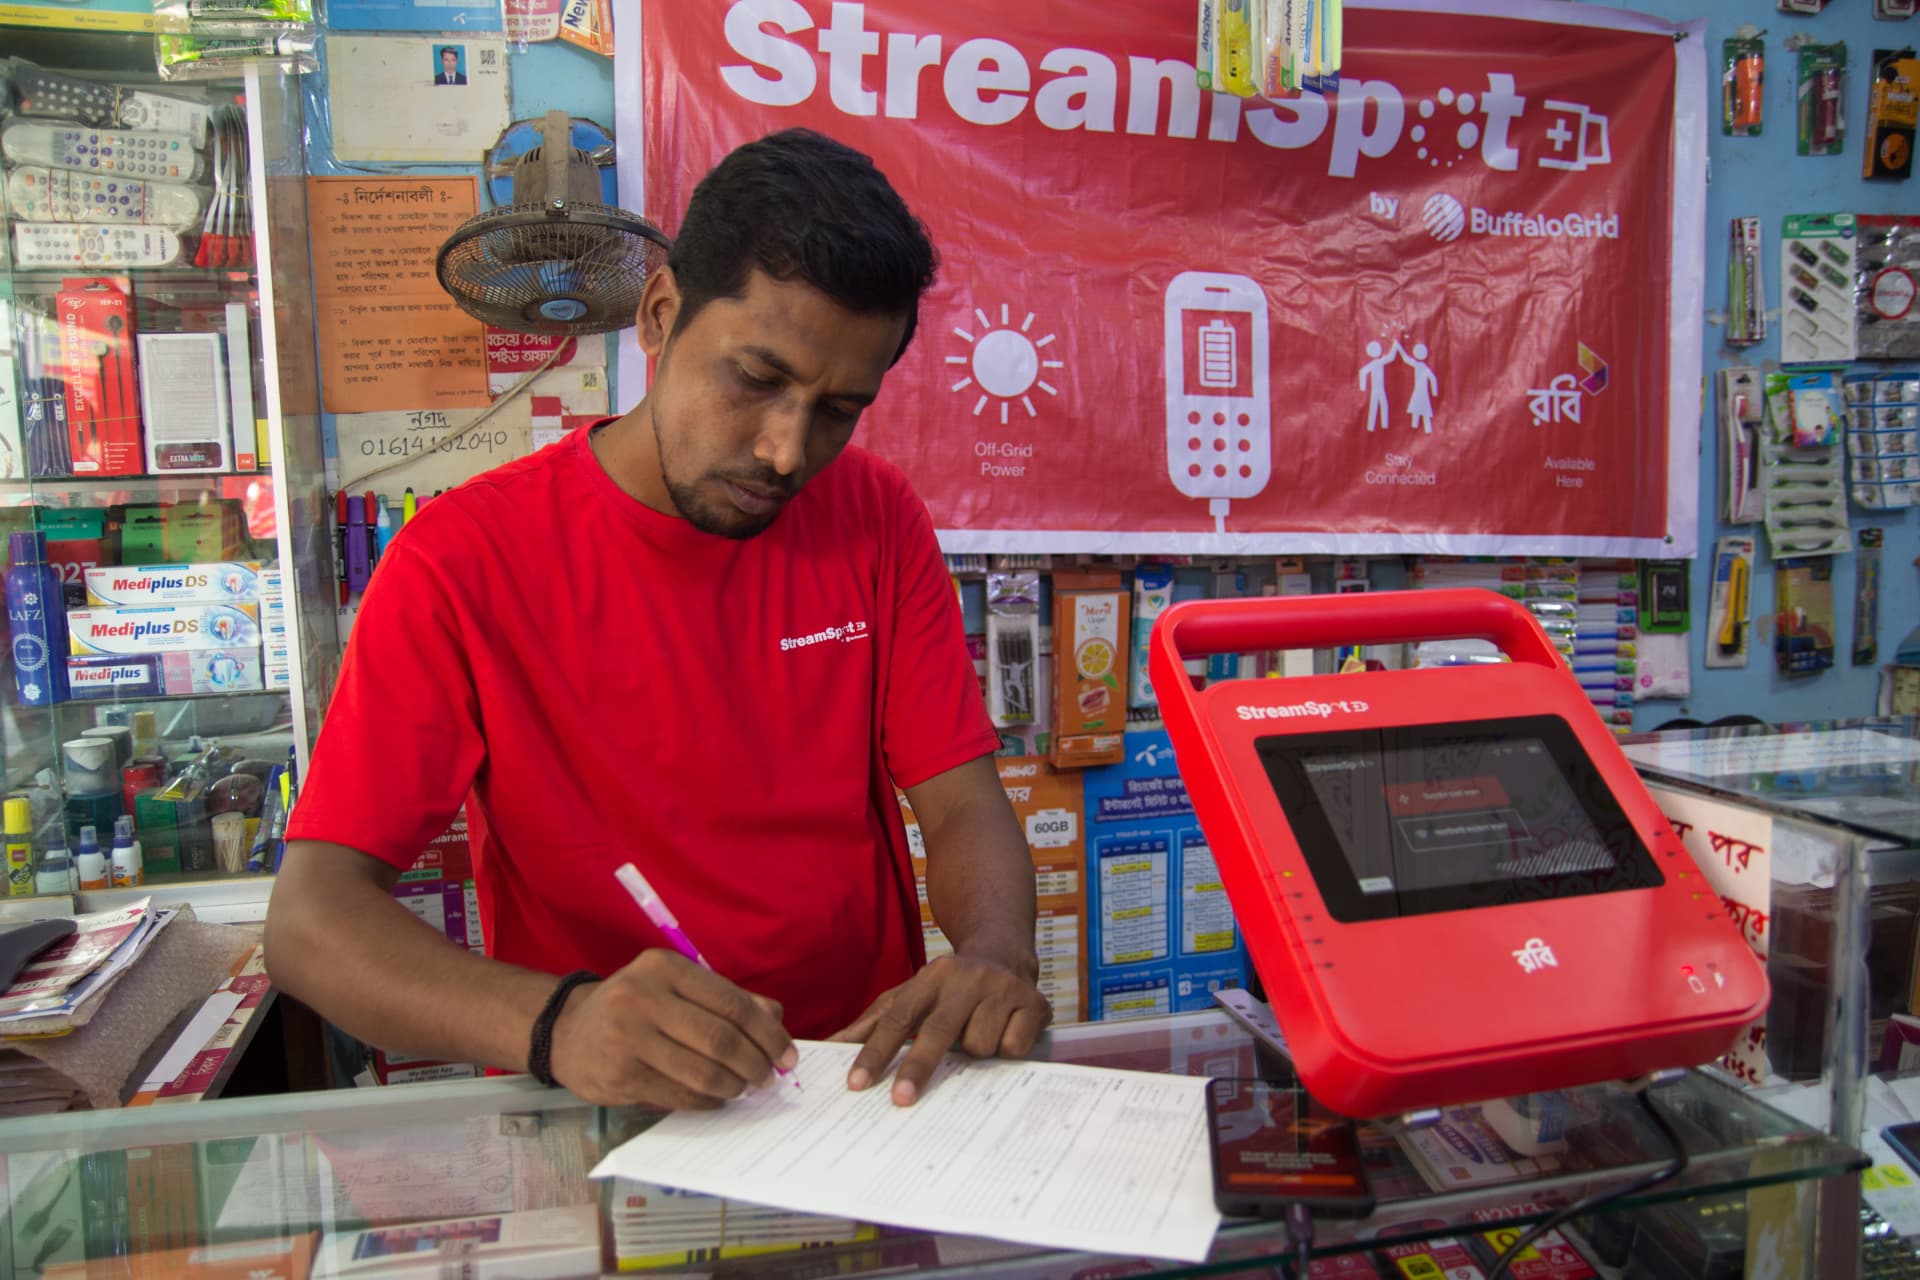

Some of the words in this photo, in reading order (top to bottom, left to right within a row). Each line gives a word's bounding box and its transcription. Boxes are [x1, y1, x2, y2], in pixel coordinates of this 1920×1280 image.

[1370, 192, 1398, 218] by
[1470, 208, 1619, 239] BuffaloGrid
[65, 312, 78, 351] SOUND
[69, 351, 86, 412] EXCELLENT
[1526, 373, 1582, 427] রবি
[975, 441, 1033, 457] Off-Grid
[169, 455, 189, 464] EXTRA
[1385, 452, 1413, 469] Stay
[1544, 456, 1596, 471] Available
[981, 461, 1027, 477] Power
[1364, 470, 1436, 486] Connected
[1555, 474, 1584, 489] Here
[112, 578, 183, 593] Mediplus
[185, 574, 208, 588] DS
[9, 609, 43, 622] LAFZ
[90, 622, 171, 640] Mediplus
[172, 619, 199, 634] DS
[74, 667, 141, 683] Mediplus
[1034, 820, 1069, 834] 60GB
[1511, 937, 1558, 974] রবি
